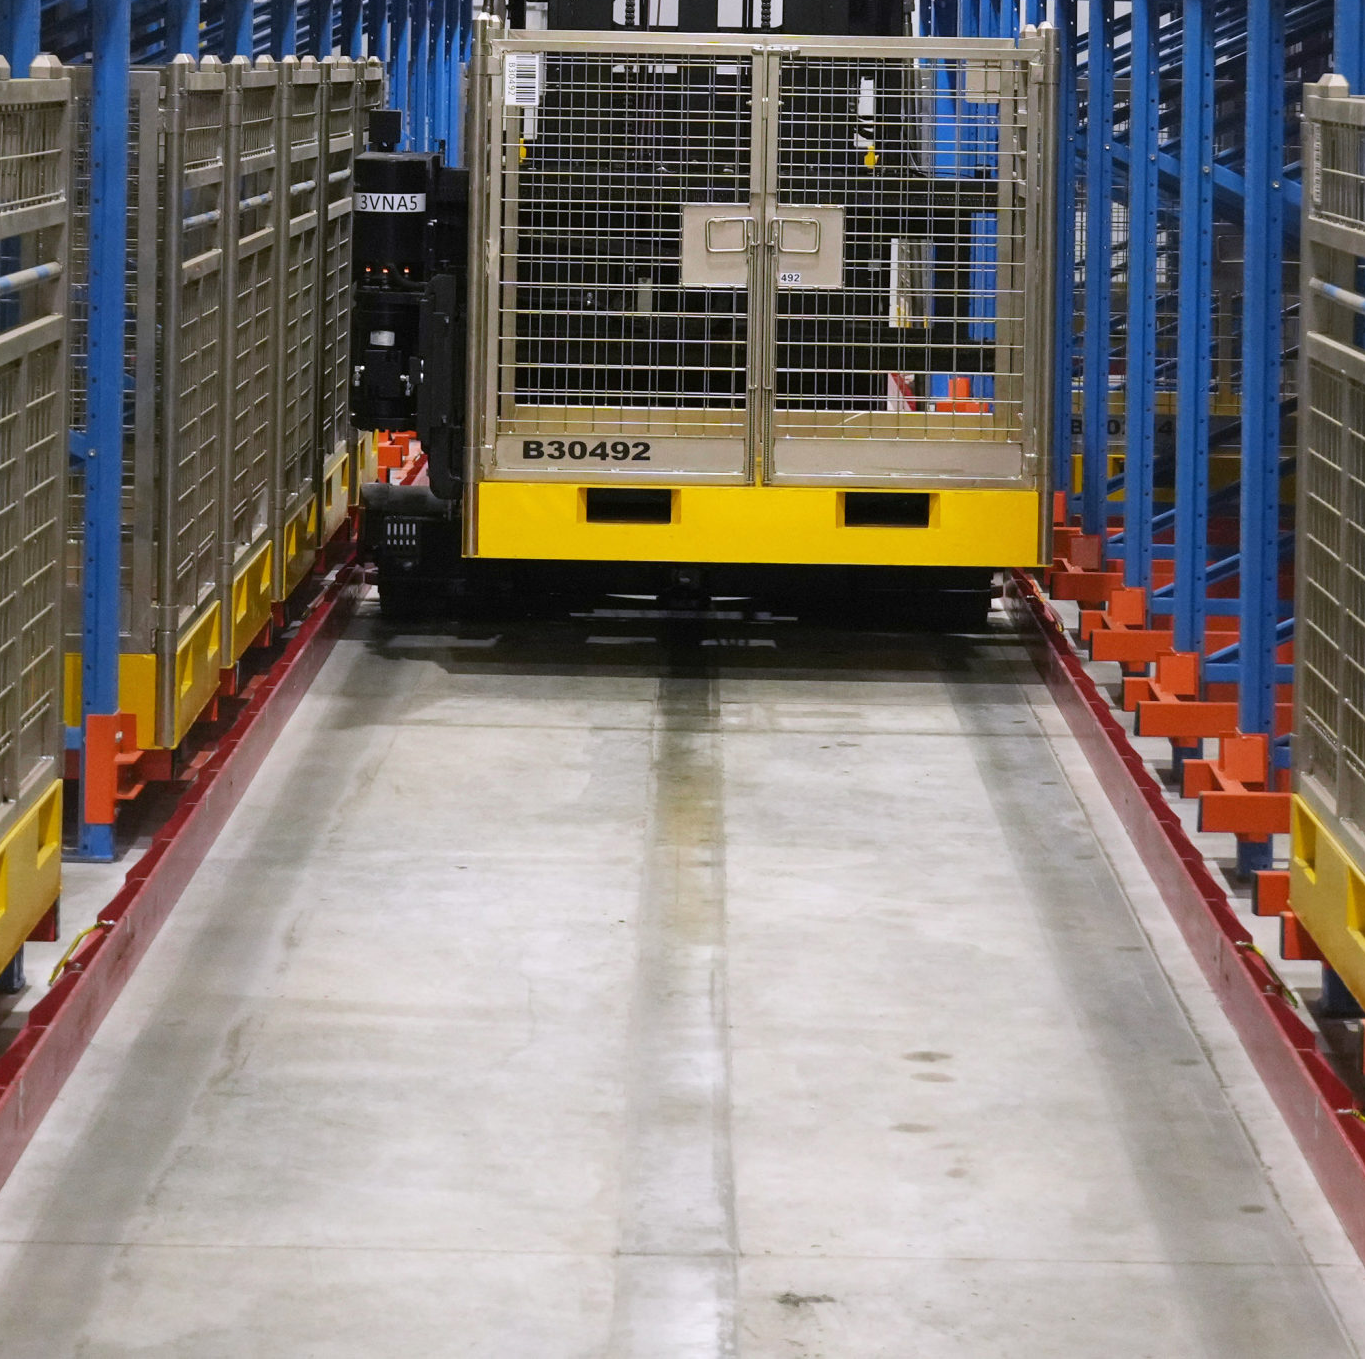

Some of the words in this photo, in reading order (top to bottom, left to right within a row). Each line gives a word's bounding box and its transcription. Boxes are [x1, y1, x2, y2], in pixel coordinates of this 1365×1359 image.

[360, 194, 418, 211] 3VNA5
[781, 273, 800, 282] 492
[522, 440, 651, 461] B30492
